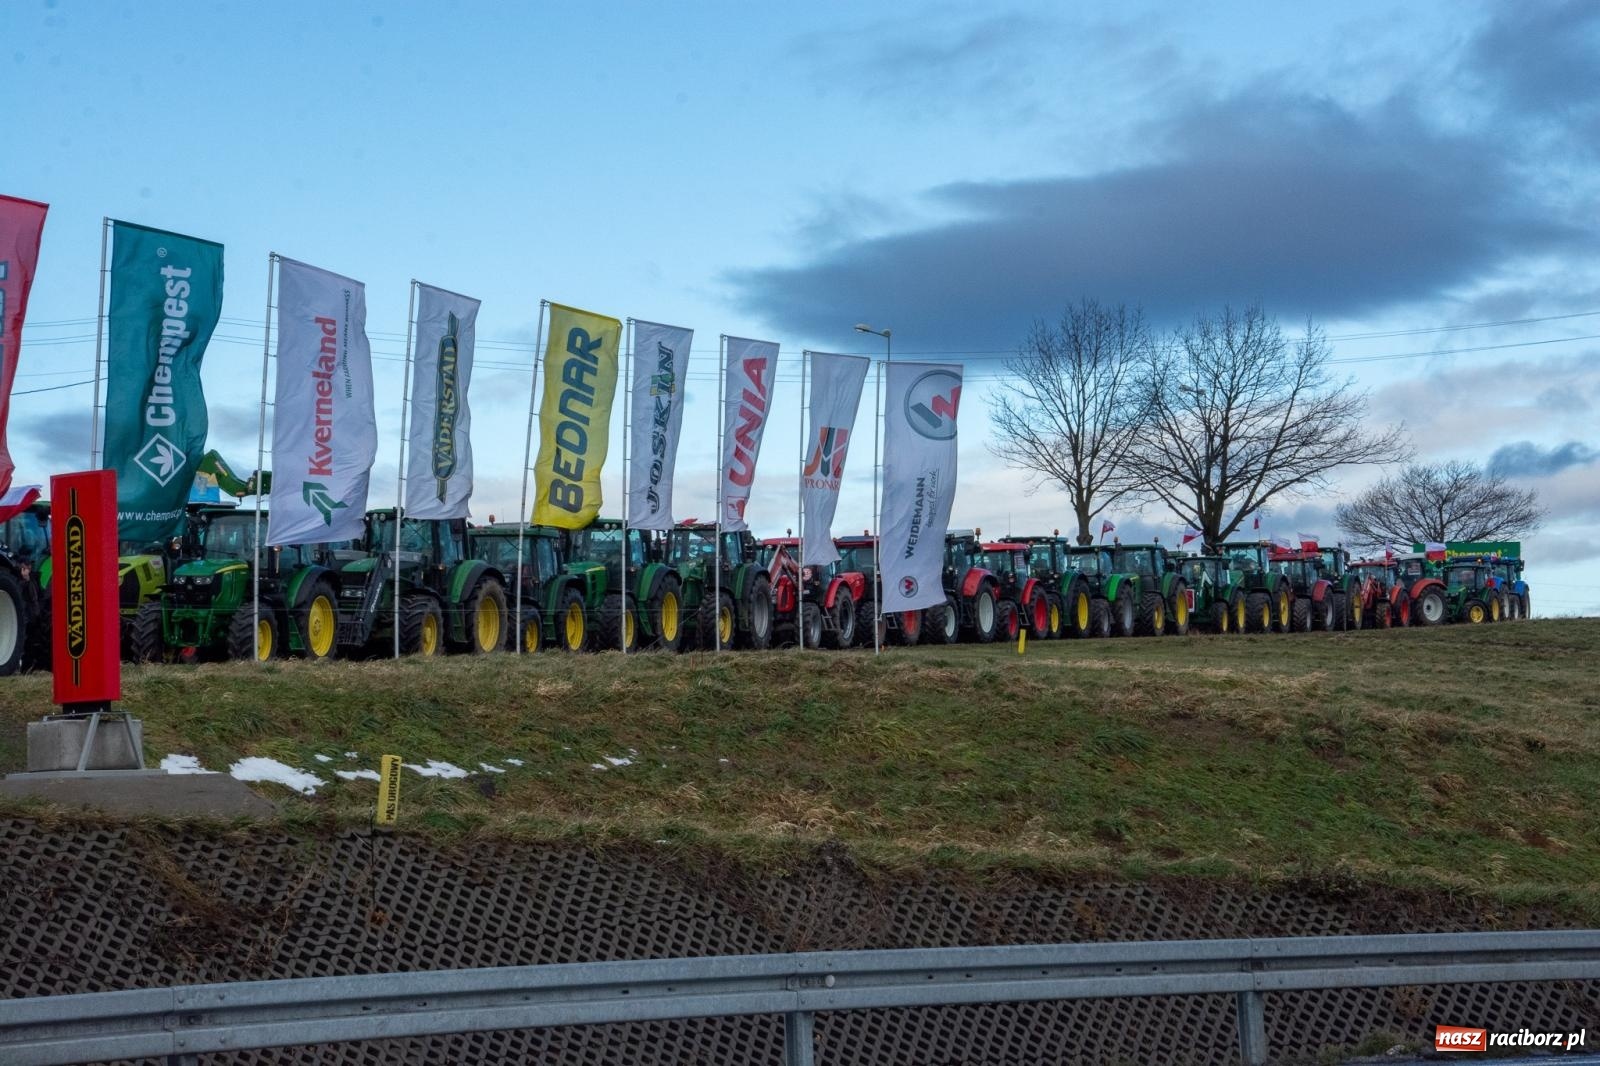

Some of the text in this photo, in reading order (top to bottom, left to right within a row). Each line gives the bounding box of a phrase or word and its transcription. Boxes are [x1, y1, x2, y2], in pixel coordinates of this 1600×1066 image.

[146, 265, 192, 427] Chempest
[308, 316, 338, 477] Kverneland
[437, 346, 457, 469] VÄDERSTAD
[548, 327, 603, 514] BEDNAR
[647, 341, 674, 515] JOSKIN
[728, 357, 768, 487] UNIA
[904, 477, 926, 560] WEIDEMANN
[69, 525, 83, 648] VÄDERSTAD
[386, 803, 395, 820] PAS
